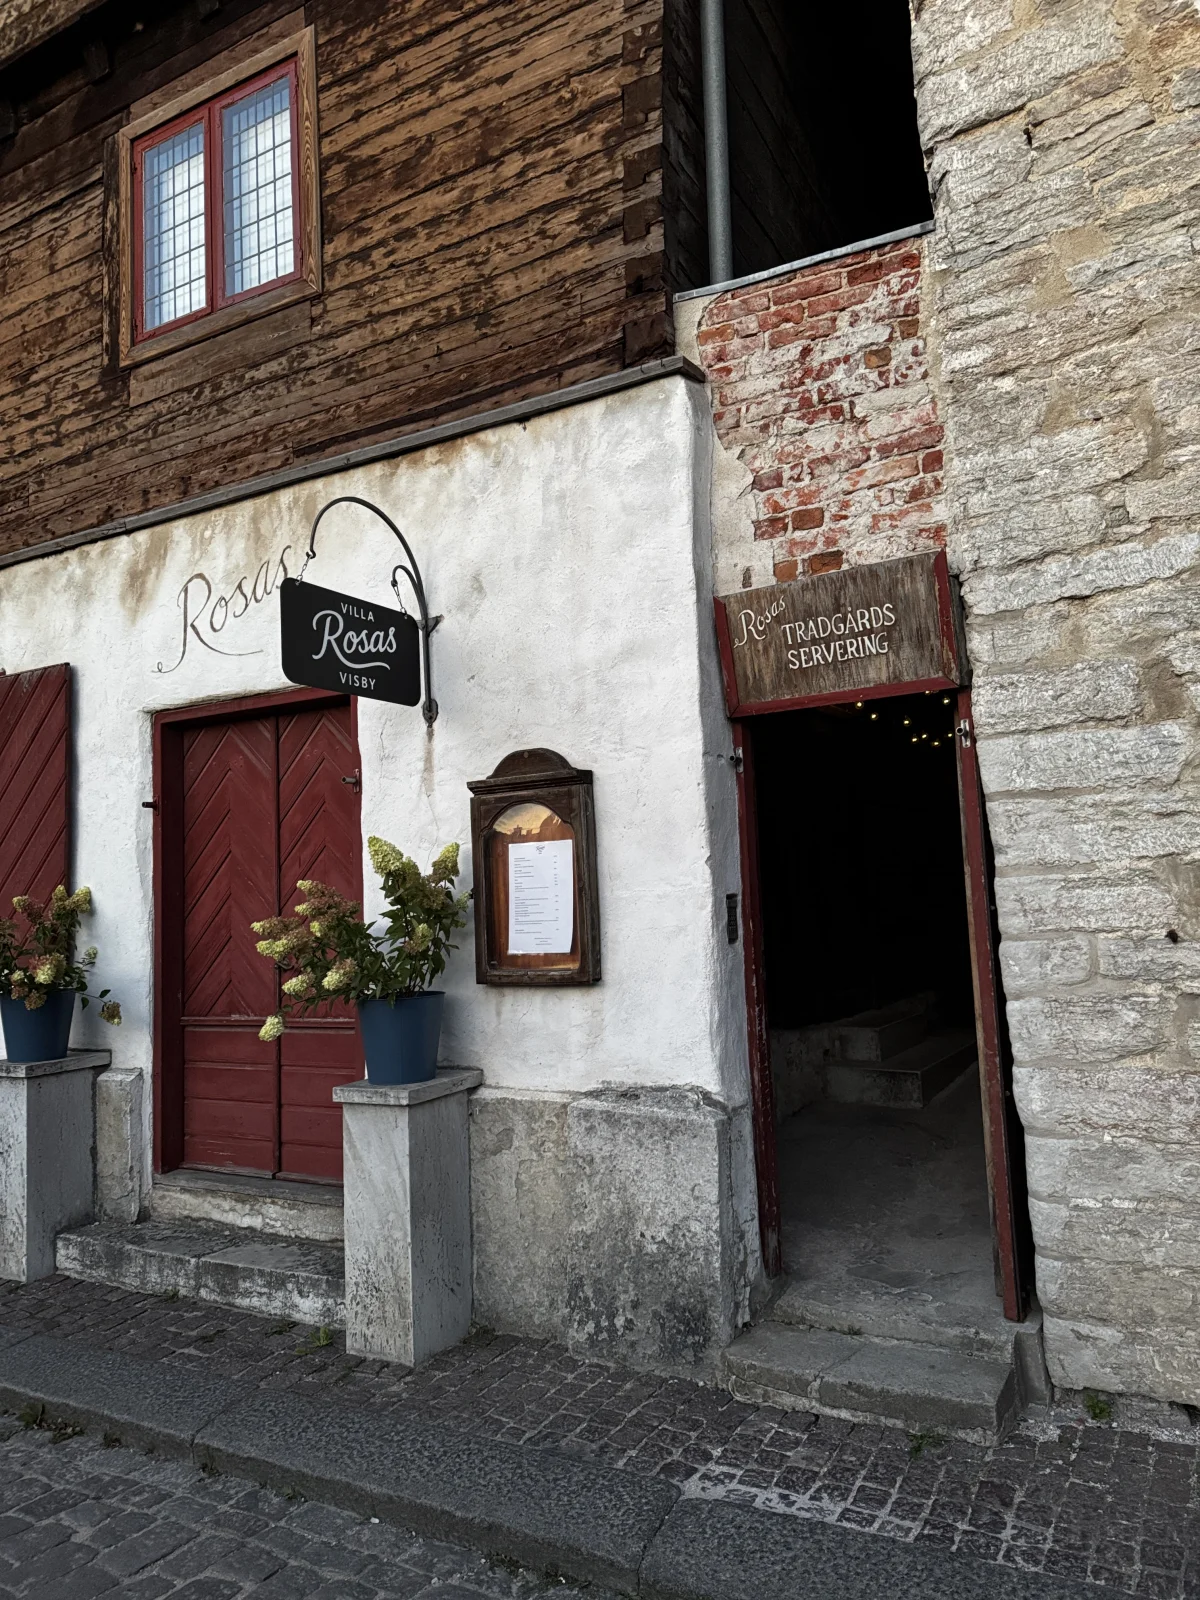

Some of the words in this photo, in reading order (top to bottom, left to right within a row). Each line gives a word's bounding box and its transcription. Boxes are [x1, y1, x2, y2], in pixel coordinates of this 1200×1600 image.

[151, 544, 292, 674] Rosas
[340, 602, 375, 622] VILLA
[733, 595, 786, 648] Rosas
[781, 603, 896, 645] TRÄDGÅRDS
[311, 609, 397, 671] Rosas
[787, 632, 889, 670] SERVERING
[339, 671, 376, 690] VISBY
